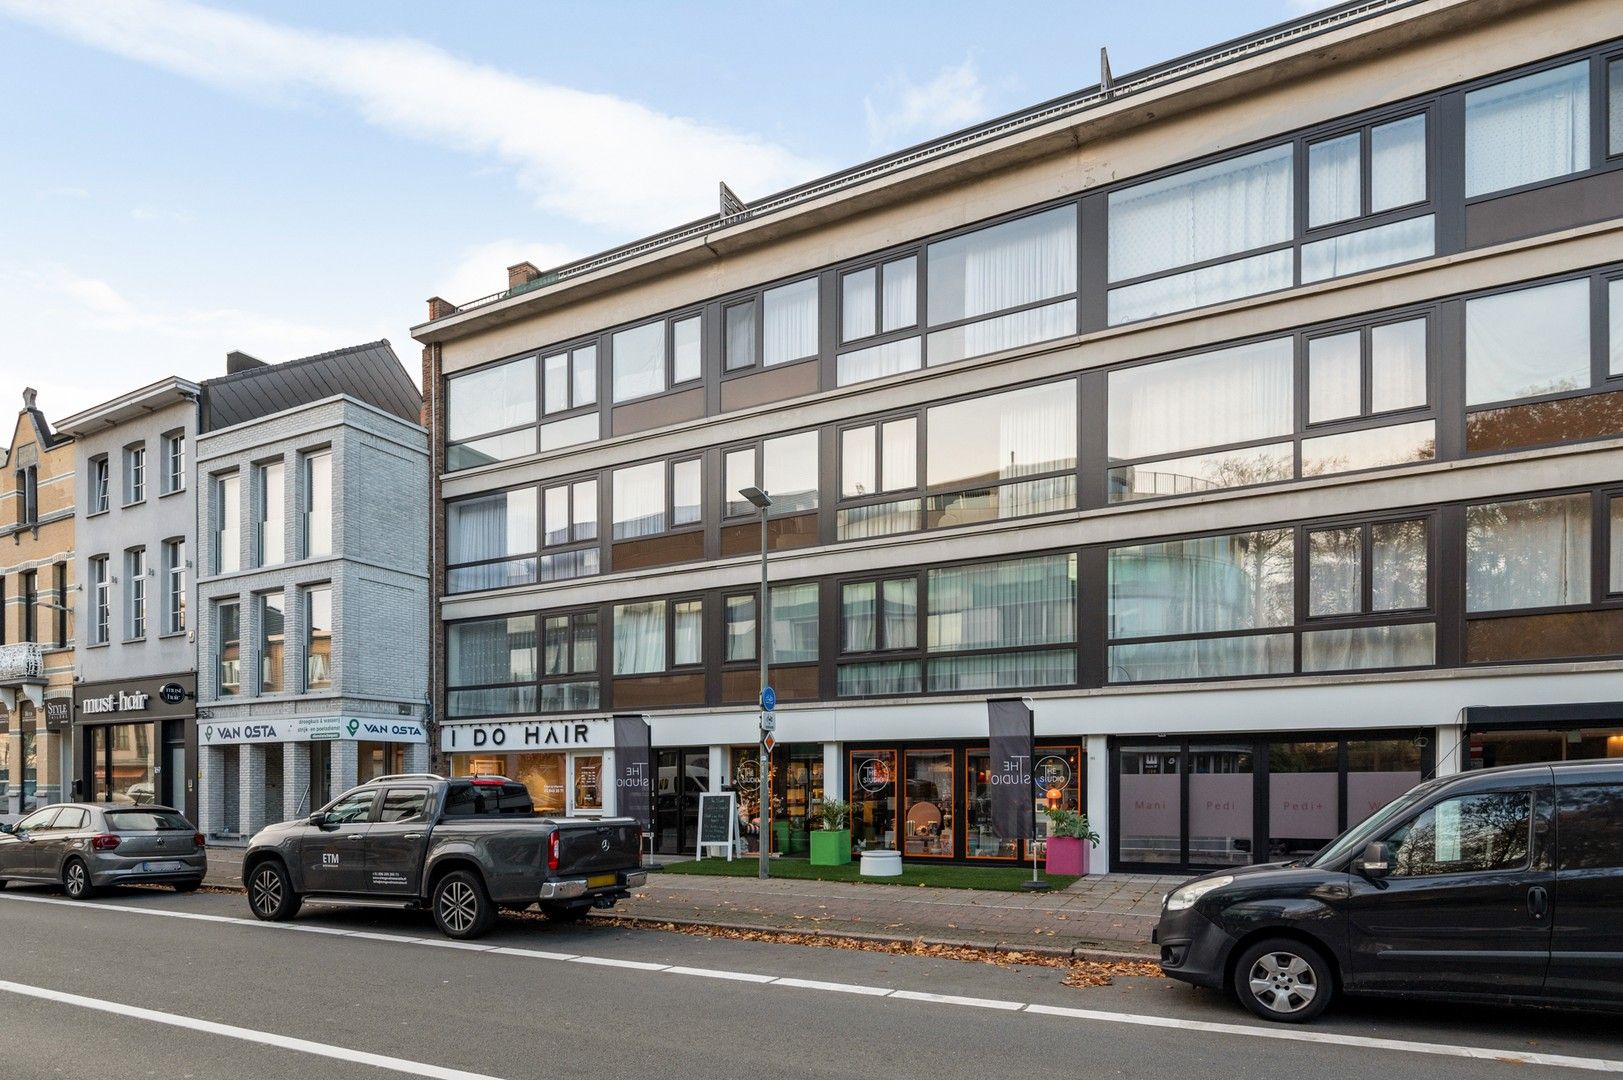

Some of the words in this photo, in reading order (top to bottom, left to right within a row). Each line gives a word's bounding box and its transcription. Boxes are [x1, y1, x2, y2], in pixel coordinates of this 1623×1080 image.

[217, 726, 241, 740] VAN
[244, 725, 277, 739] OSTA
[363, 723, 388, 735] VAN
[391, 726, 422, 736] OSTA
[451, 729, 456, 747] I
[473, 727, 506, 747] DO
[525, 724, 588, 745] HAIR
[1040, 764, 1057, 775] THE
[1040, 775, 1065, 783] STUDIO
[1134, 801, 1166, 809] Mani
[1206, 801, 1235, 810] Pedi
[322, 853, 339, 864] ETM
